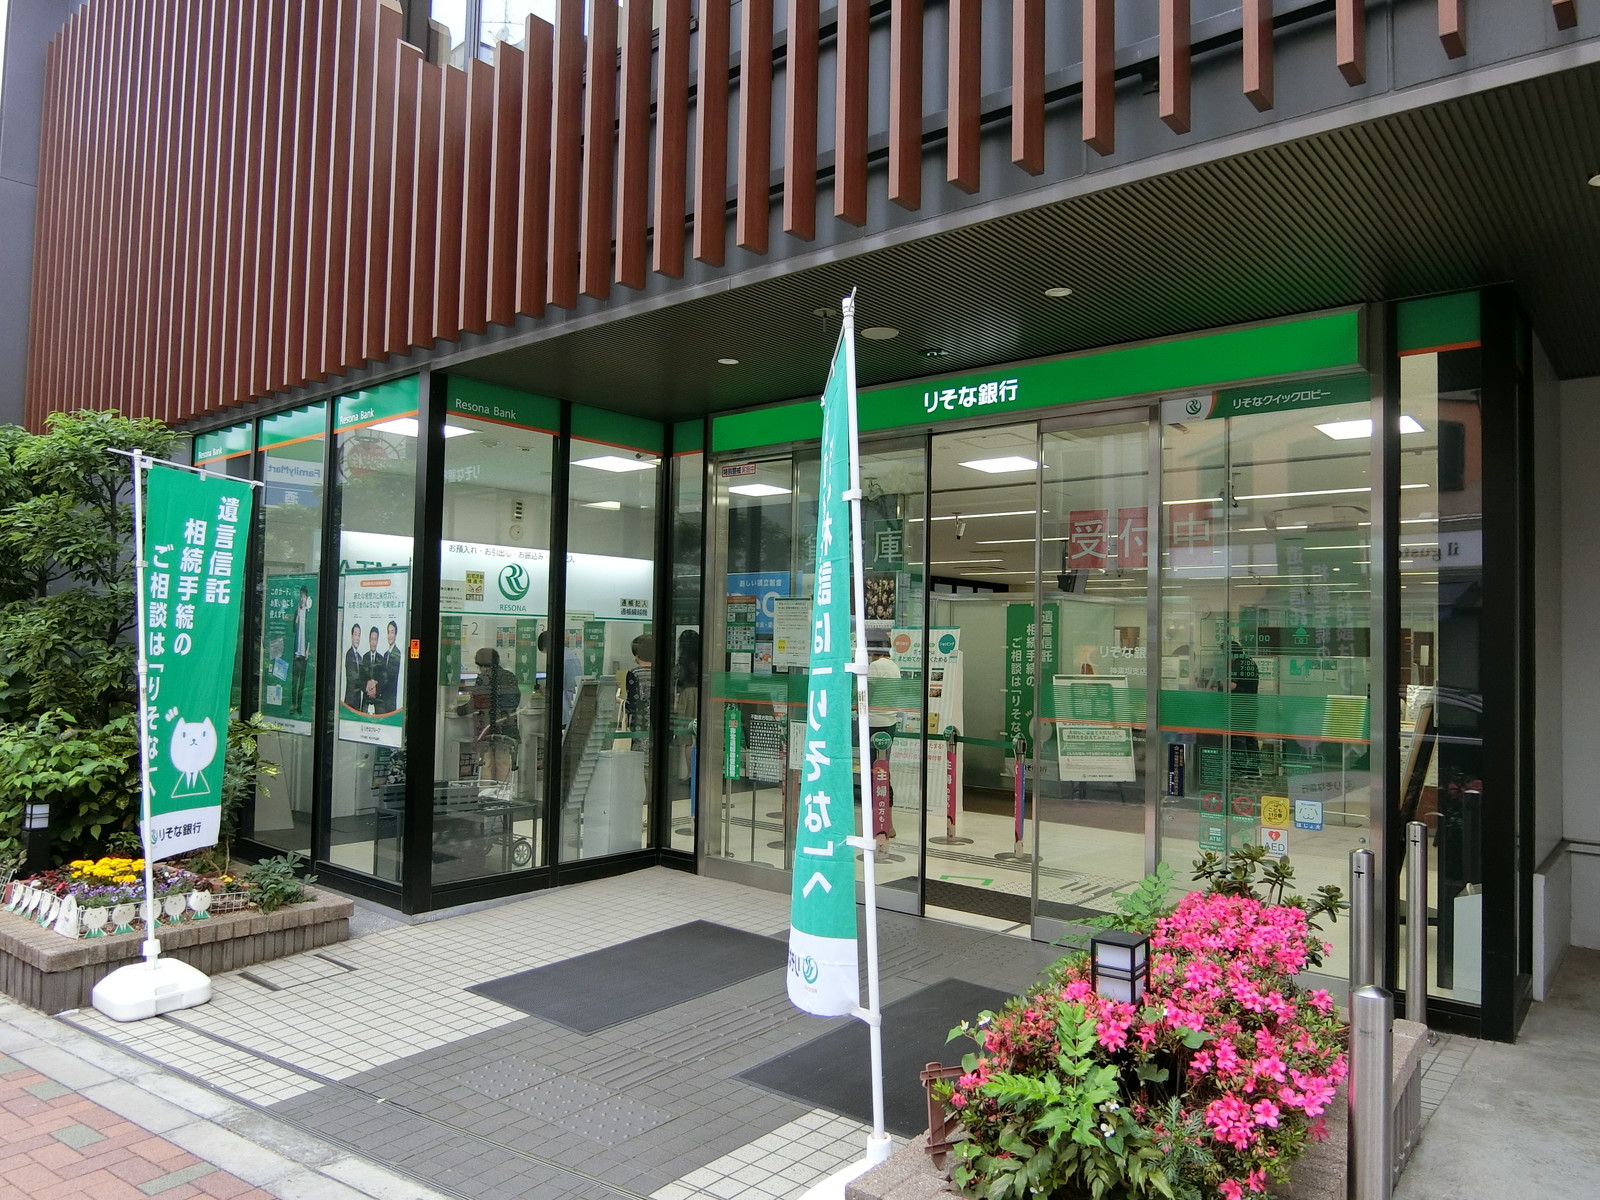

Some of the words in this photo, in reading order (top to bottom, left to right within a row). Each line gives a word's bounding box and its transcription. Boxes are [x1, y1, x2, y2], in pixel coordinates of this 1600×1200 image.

[923, 379, 1018, 413] りそな銀行
[1233, 389, 1331, 409] りそなクイックロビー
[339, 413, 359, 425] Resona
[360, 408, 375, 420] Bank
[455, 398, 490, 414] Resona
[493, 406, 517, 420] Bank
[198, 449, 212, 459] Resona
[213, 446, 224, 456] Bank
[204, 496, 240, 605] 遺言信託
[173, 517, 208, 656] 相続手続の
[499, 604, 527, 612] RESONA
[471, 621, 479, 636] 2
[876, 769, 888, 830] 主婦の方も！
[158, 821, 202, 842] りそな銀行
[1264, 842, 1286, 852] AED
